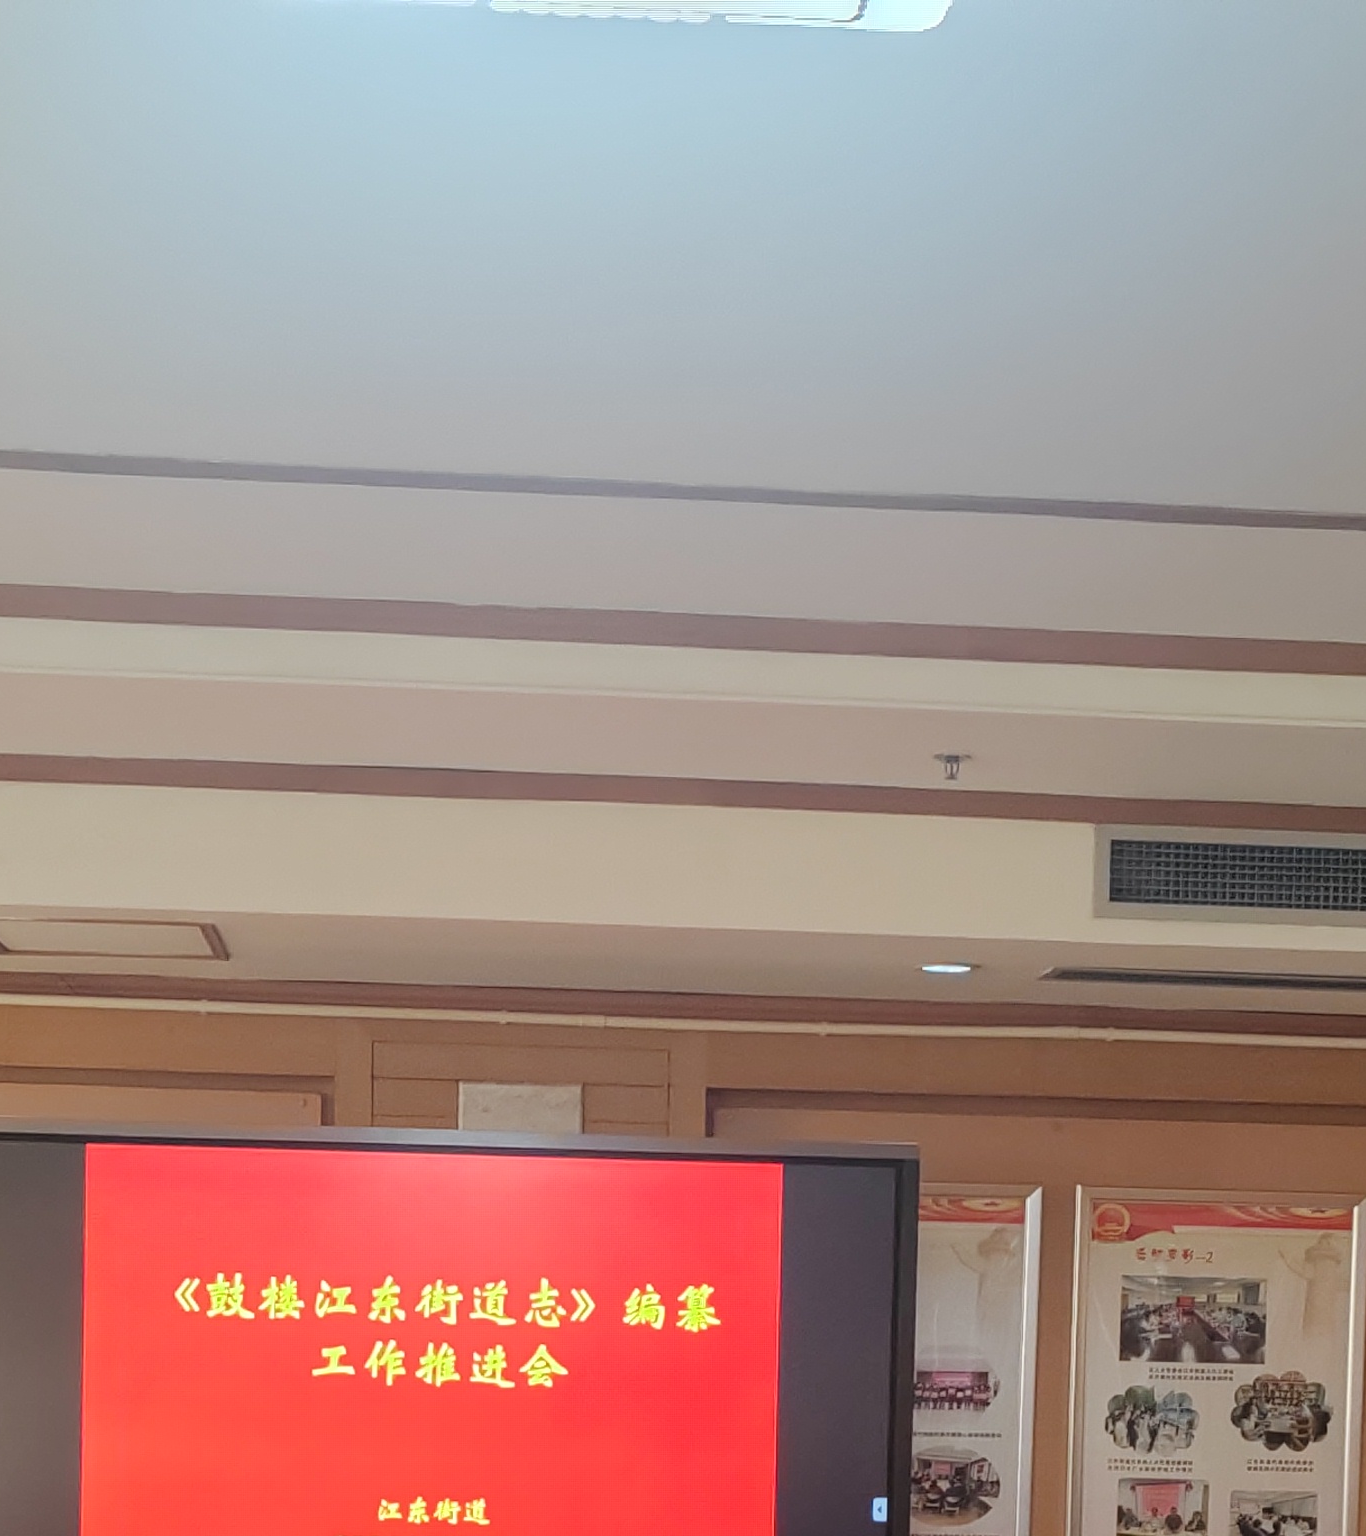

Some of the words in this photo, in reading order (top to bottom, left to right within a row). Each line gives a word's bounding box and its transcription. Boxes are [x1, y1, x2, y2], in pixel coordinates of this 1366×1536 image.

[174, 1274, 721, 1332] 《鼓楼江东街道志》编纂
[312, 1342, 569, 1388] 工作推进会
[378, 1497, 490, 1527] 江东街道
